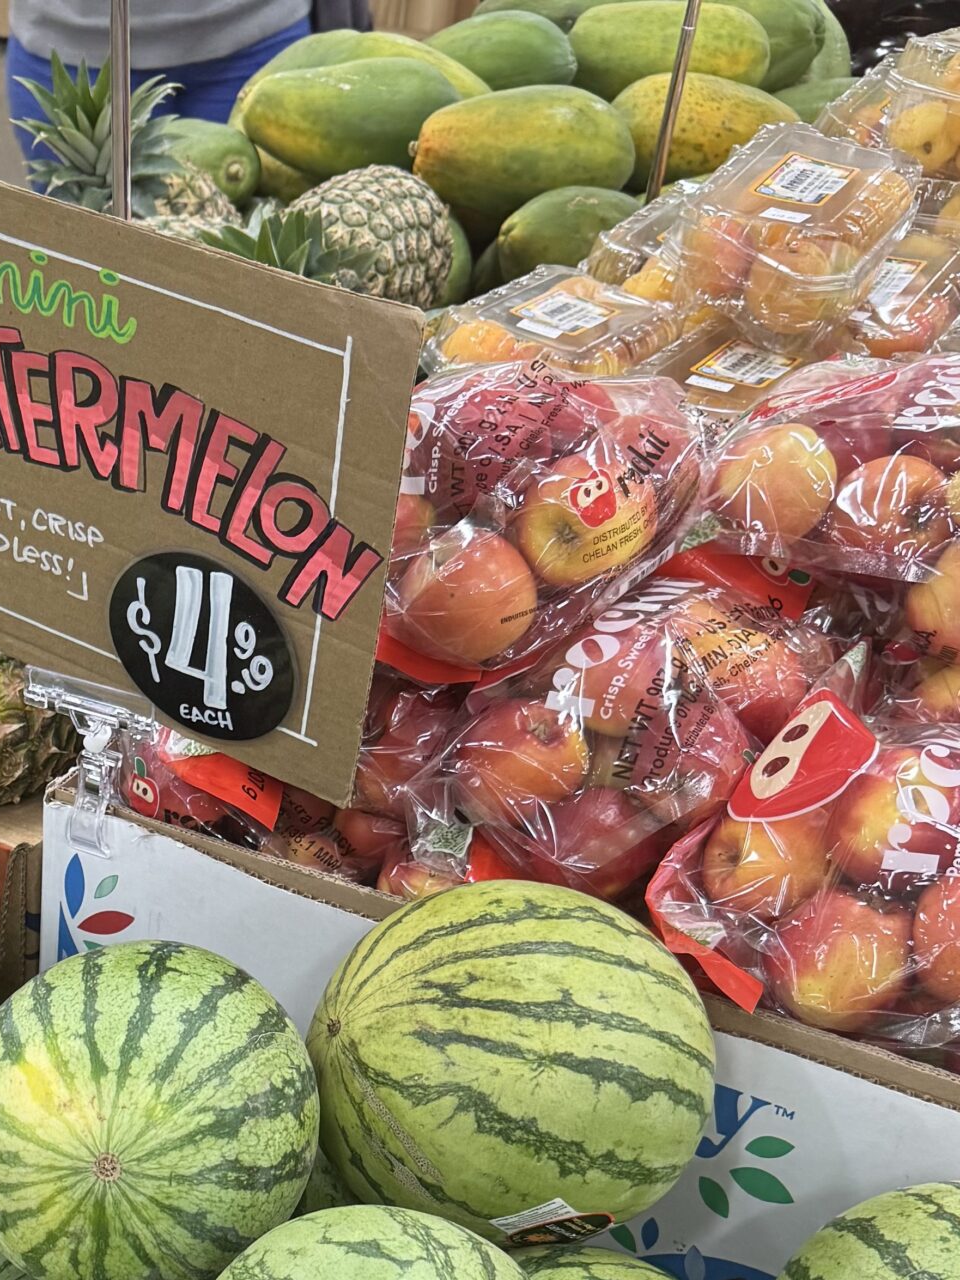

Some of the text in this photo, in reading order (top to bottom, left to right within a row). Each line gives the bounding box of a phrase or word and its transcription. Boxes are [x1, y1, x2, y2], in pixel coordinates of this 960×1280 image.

[31, 508, 105, 545] CRISP
[582, 542, 618, 565] CHELAN
[600, 671, 630, 719] Crisp,
[178, 701, 234, 732] EACH
